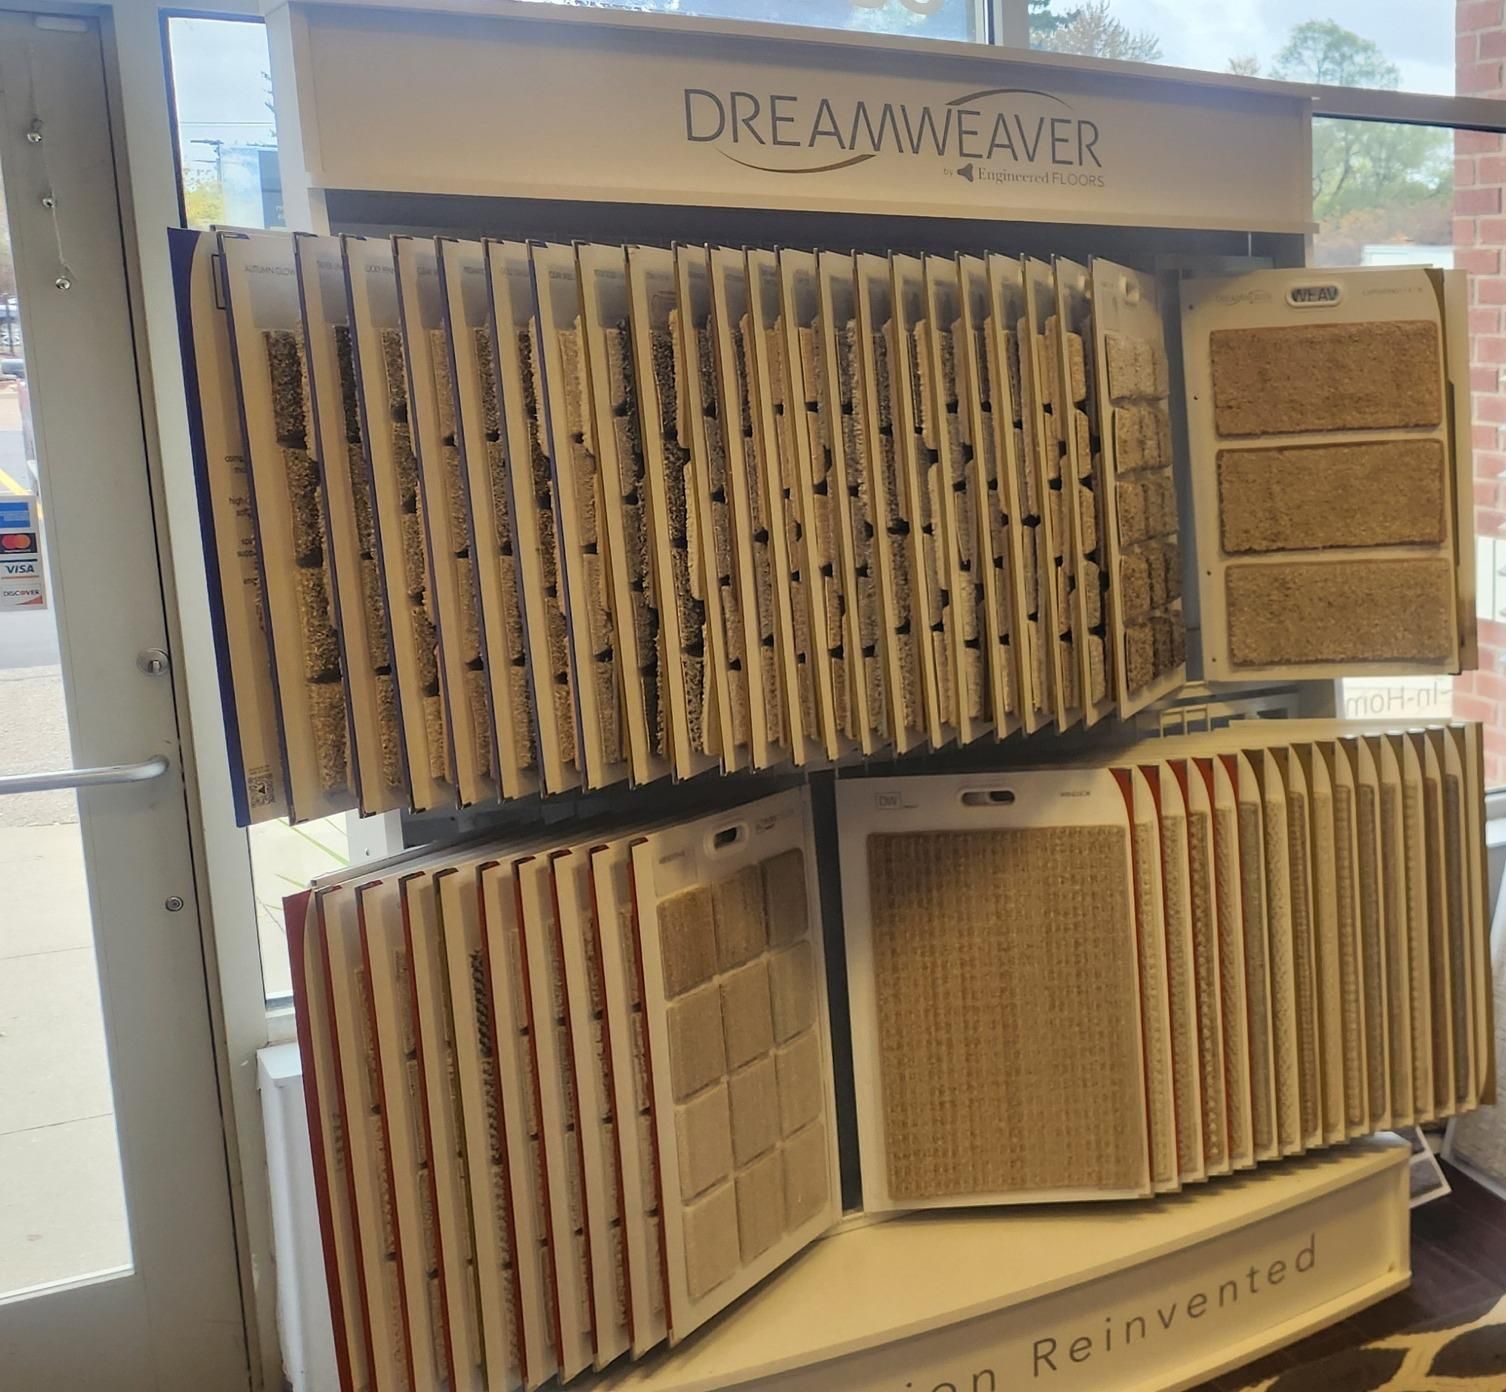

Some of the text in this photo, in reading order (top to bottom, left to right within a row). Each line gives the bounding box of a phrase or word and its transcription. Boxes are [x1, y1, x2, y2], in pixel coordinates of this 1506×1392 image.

[684, 88, 1102, 168] DREAMWEAVER
[977, 167, 1050, 185] Engineered
[1051, 172, 1105, 188] FLOORS
[5, 564, 35, 574] VISA
[1032, 1232, 1317, 1378] Reinvented
